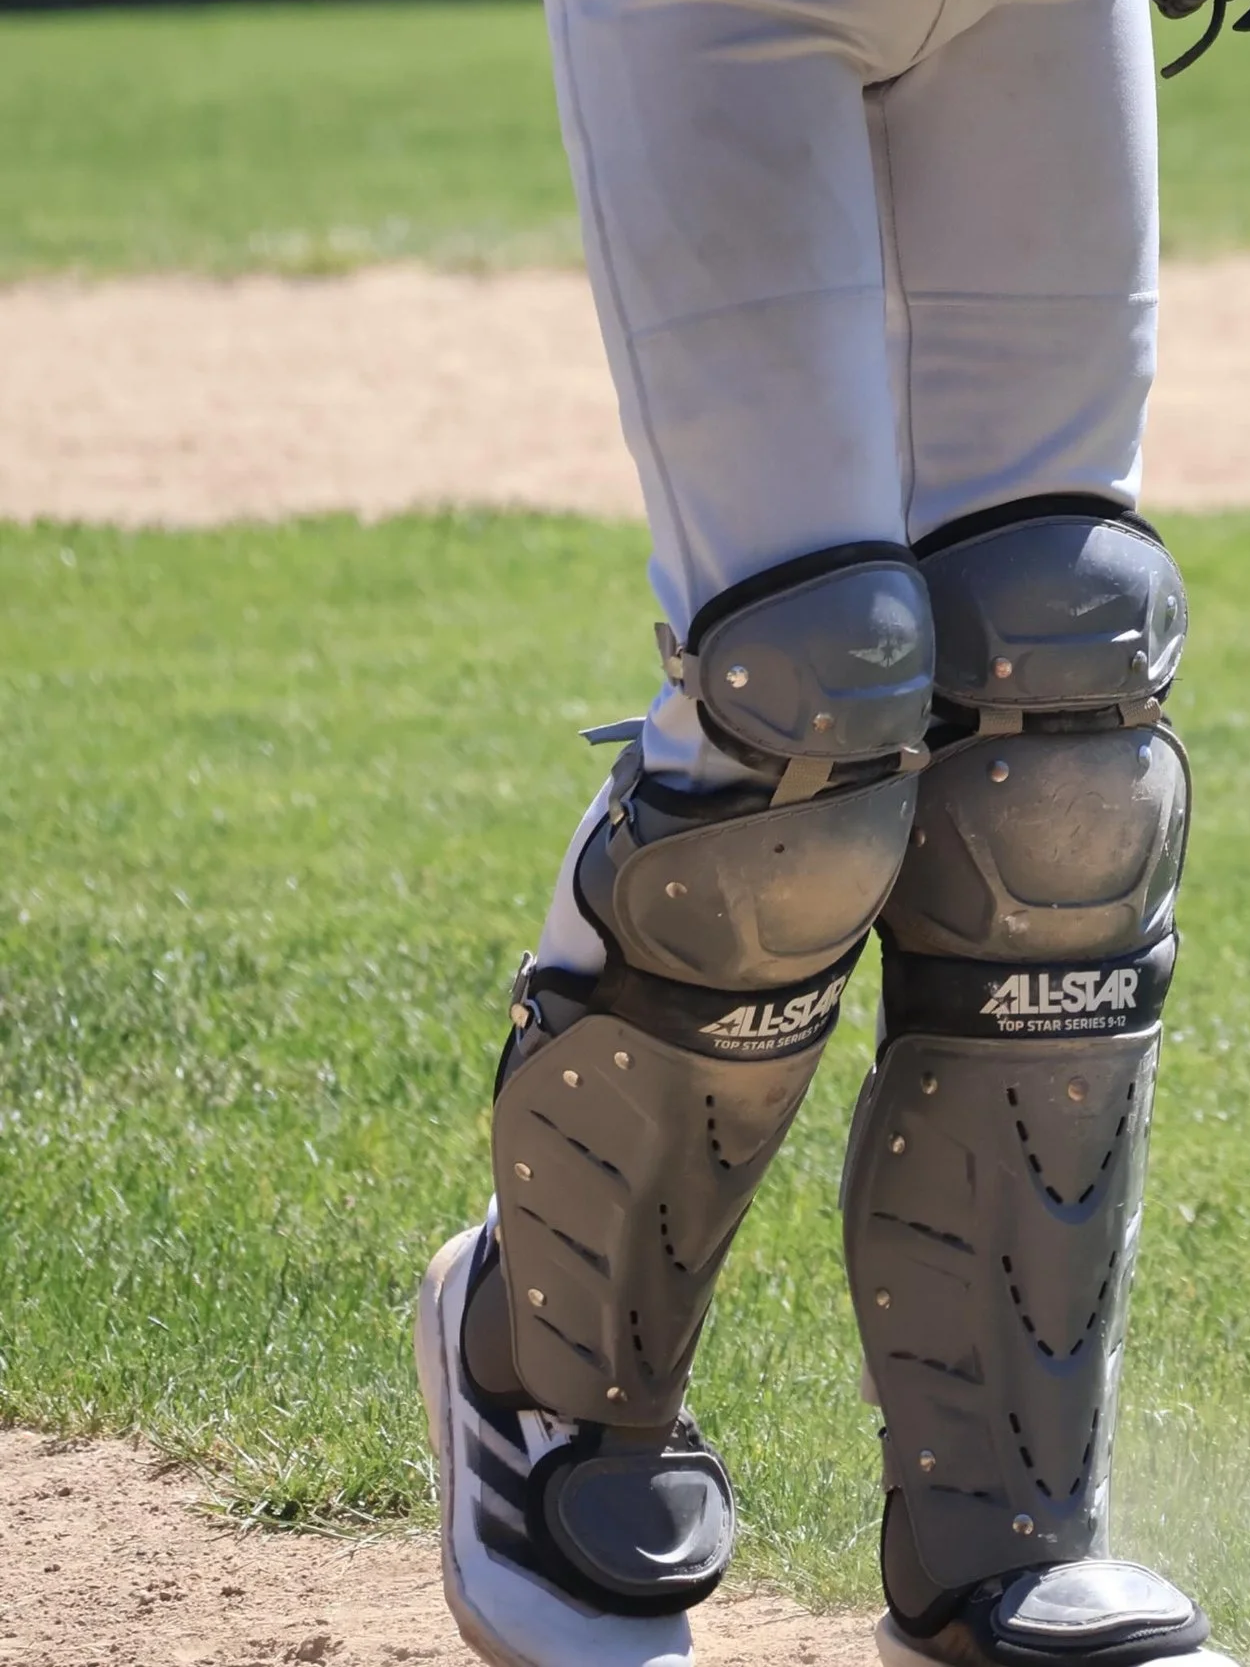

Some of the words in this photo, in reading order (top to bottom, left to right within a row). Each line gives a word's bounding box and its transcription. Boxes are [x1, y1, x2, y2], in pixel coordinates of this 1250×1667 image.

[699, 975, 847, 1037] ALL-STAR
[979, 968, 1139, 1015] ALL-STAR
[714, 1038, 741, 1050] TOP
[742, 1038, 774, 1051] STAR
[777, 1026, 813, 1048] SERIES
[998, 1019, 1025, 1032] TOP
[1027, 1019, 1062, 1032] STAR
[1065, 1016, 1106, 1030] SERIES
[1107, 1015, 1127, 1028] 9-12
